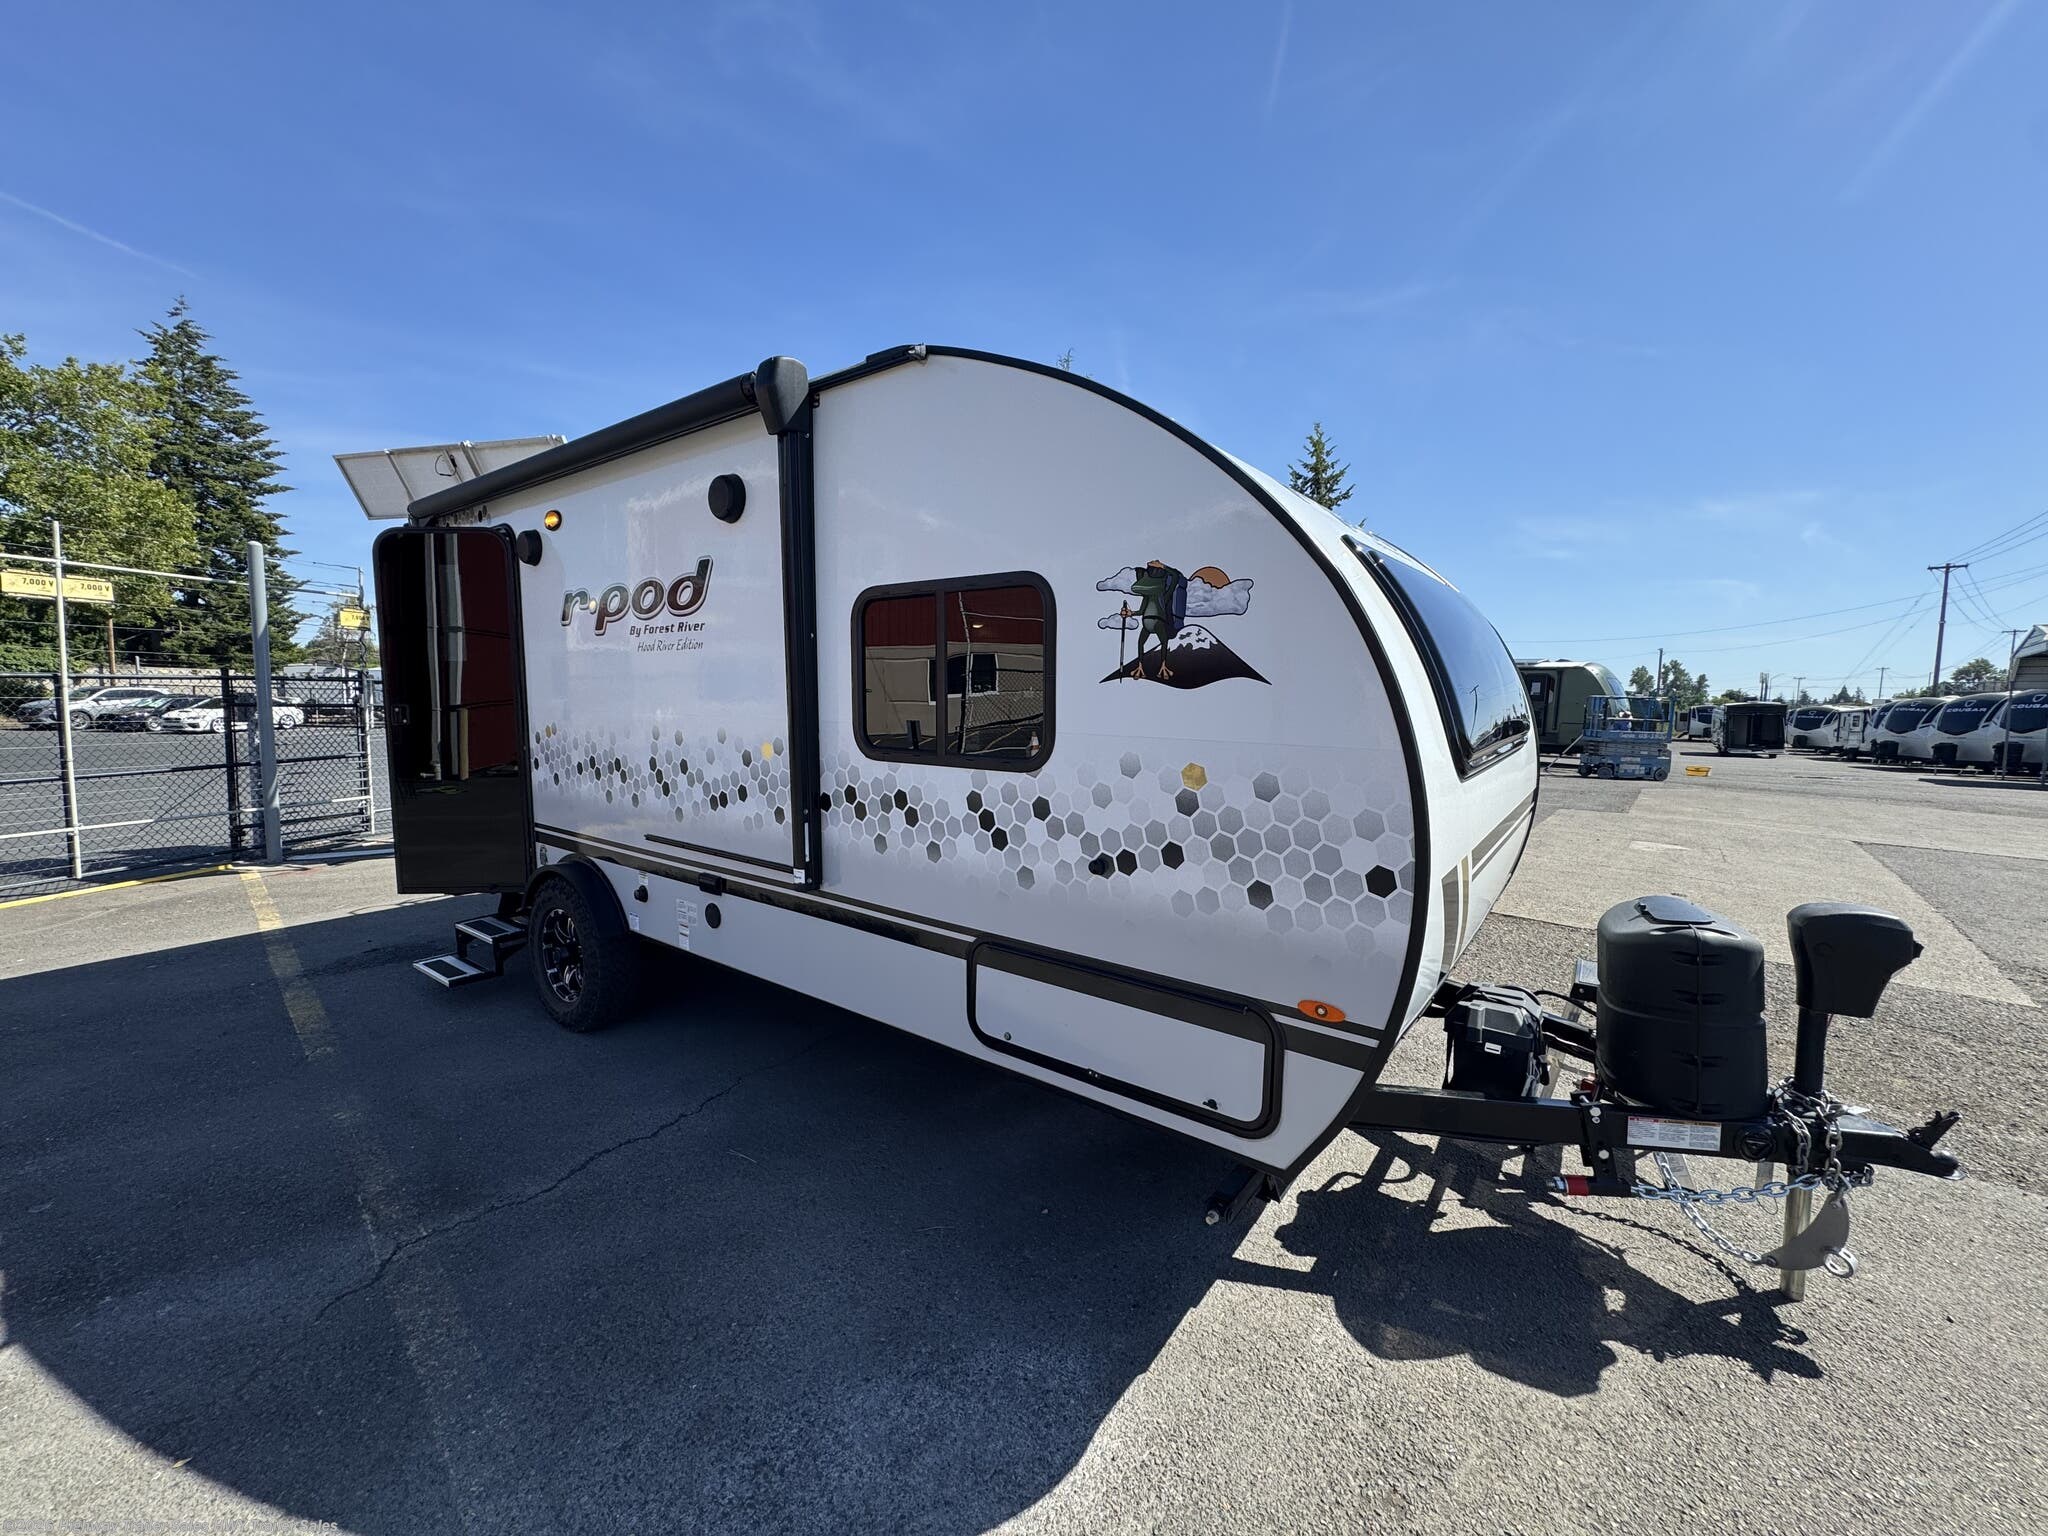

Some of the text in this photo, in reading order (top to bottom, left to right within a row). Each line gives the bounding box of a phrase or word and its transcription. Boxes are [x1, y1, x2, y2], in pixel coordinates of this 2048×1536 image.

[22, 577, 46, 586] 7,000
[81, 583, 103, 591] 7,000
[629, 621, 706, 638] By Forest River
[637, 637, 704, 652] Hood River Edition
